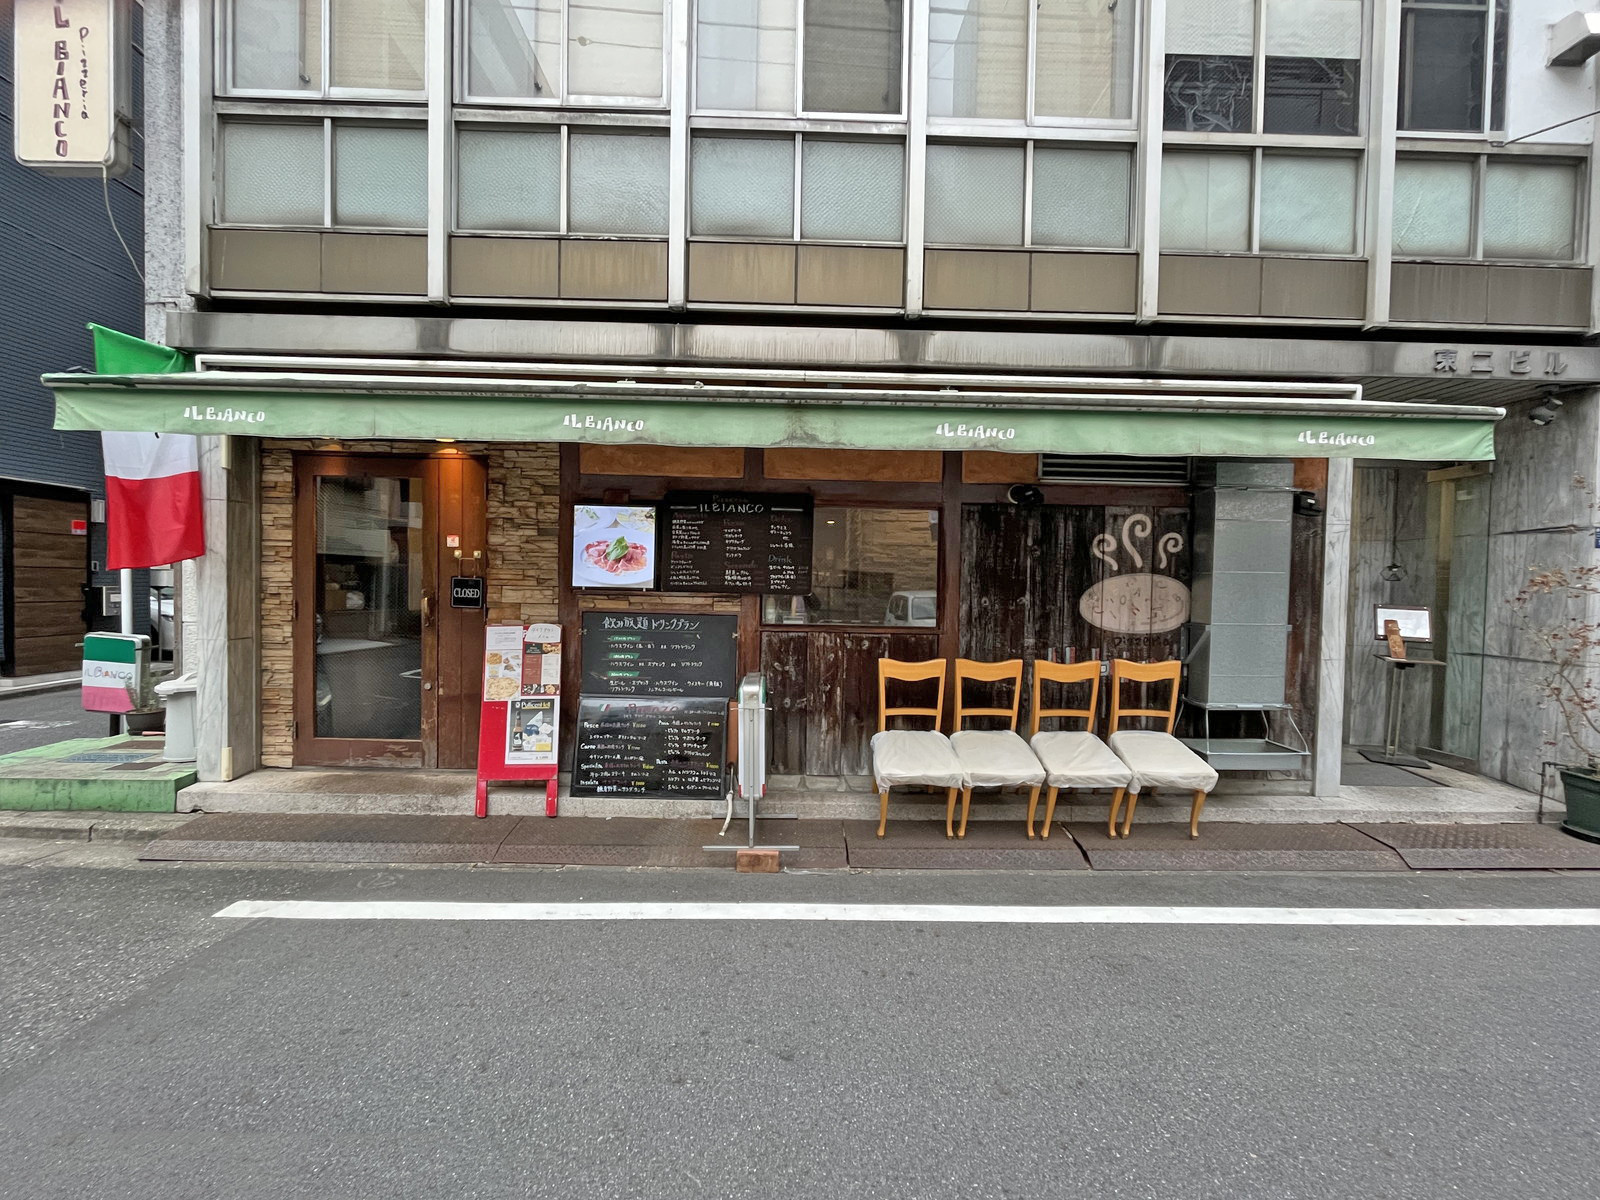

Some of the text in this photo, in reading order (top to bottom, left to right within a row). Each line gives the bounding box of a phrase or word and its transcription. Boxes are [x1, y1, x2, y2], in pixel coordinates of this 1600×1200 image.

[52, 40, 71, 158] BIANCO
[1434, 349, 1568, 375] 東二ビル
[768, 554, 792, 564] Drink
[453, 587, 480, 598] CLOSED
[602, 616, 700, 631] 飲み放題 ドリンクプラン
[583, 721, 599, 729] Pesce
[580, 742, 597, 750] Carne
